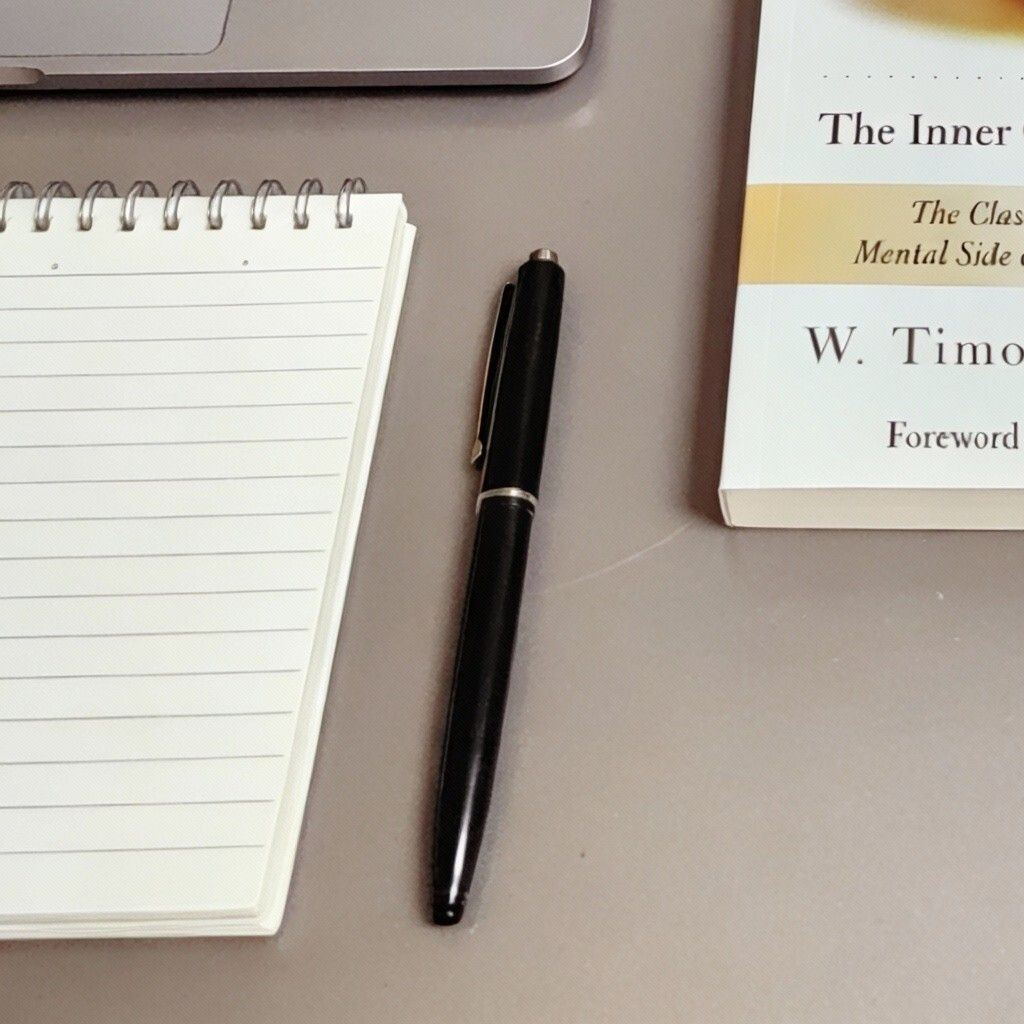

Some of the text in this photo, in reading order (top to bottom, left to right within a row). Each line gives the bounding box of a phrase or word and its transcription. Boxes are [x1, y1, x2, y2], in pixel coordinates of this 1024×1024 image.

[819, 110, 896, 146] The
[909, 113, 1012, 147] Inner
[911, 199, 960, 225] The
[853, 239, 950, 266] Mental
[955, 241, 1012, 267] Side
[803, 325, 864, 366] W.
[886, 420, 1019, 450] Foreword
